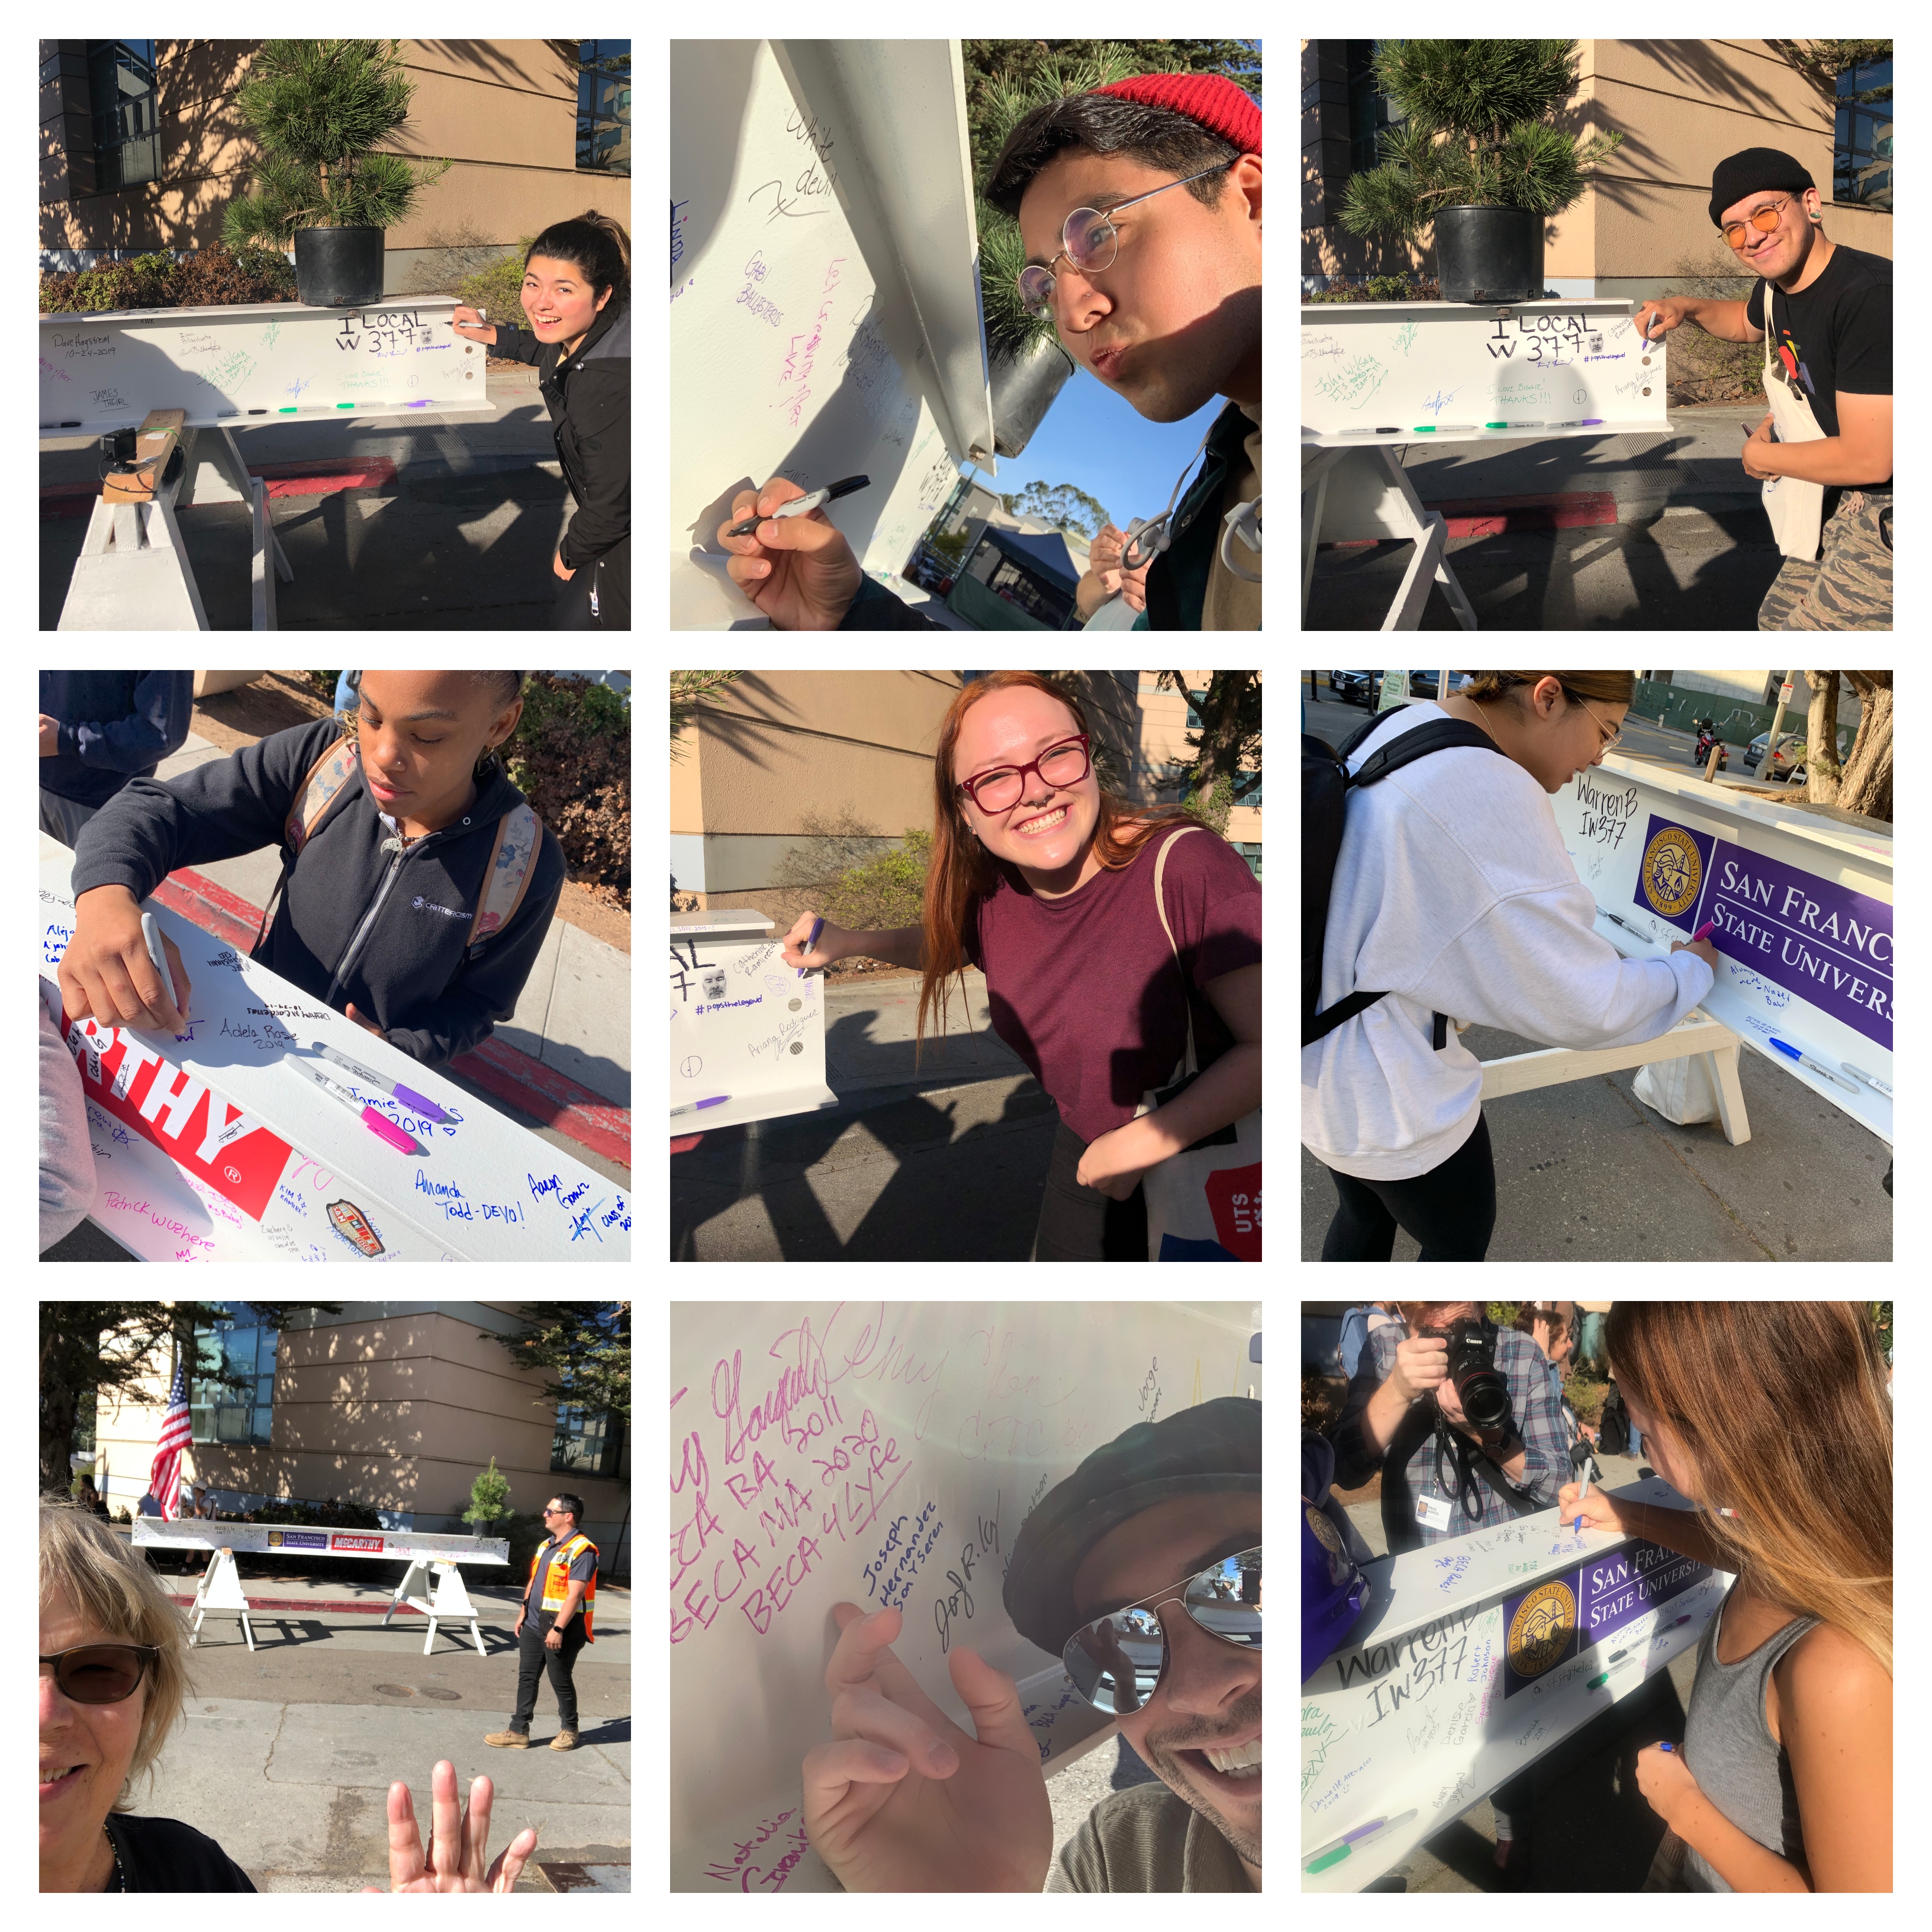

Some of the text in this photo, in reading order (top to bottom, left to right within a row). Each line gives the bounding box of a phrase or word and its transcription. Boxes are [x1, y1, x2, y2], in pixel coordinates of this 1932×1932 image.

[338, 310, 428, 334] I LOCAL
[1489, 312, 1598, 339] I LOCAL
[336, 328, 417, 353] W 377
[1486, 333, 1586, 362] W 377
[89, 389, 118, 401] JAMES
[1579, 811, 1627, 850] IW377
[1646, 833, 1699, 909] SAN FRANCISCO STATE UNIVERSITY
[425, 903, 473, 919] CRITTERCISM
[1655, 897, 1673, 911] 1899
[1720, 860, 1893, 967] SAN FRANC
[1711, 903, 1775, 954] STATE
[219, 1018, 300, 1041] Adela Rose
[253, 1039, 286, 1049] 2019
[104, 1191, 150, 1215] Patrick
[279, 1184, 295, 1199] KIM
[279, 1194, 308, 1218] RAMIREZ
[331, 1205, 346, 1223] SAN
[1232, 1193, 1252, 1234] UTS
[343, 1222, 372, 1252] FRANCISCO
[724, 1394, 843, 1510] BA 2011
[759, 1478, 813, 1547] MA
[812, 1408, 880, 1487] 2020
[863, 1514, 909, 1598] Joseph
[880, 1501, 936, 1608] Hernandez
[1591, 1560, 1628, 1596] SAN
[1633, 1545, 1676, 1575] FRAN
[740, 1535, 823, 1635] BECA
[1590, 1590, 1634, 1629] STATE
[1512, 1586, 1574, 1671] SAN FRANCISCO STATE UNIVERSITY
[1467, 1644, 1482, 1682] Robert
[1480, 1638, 1492, 1683] Johnson
[1532, 1653, 1554, 1671] 1899
[1366, 1635, 1468, 1728] IW377
[1475, 1692, 1489, 1725] SANDY
